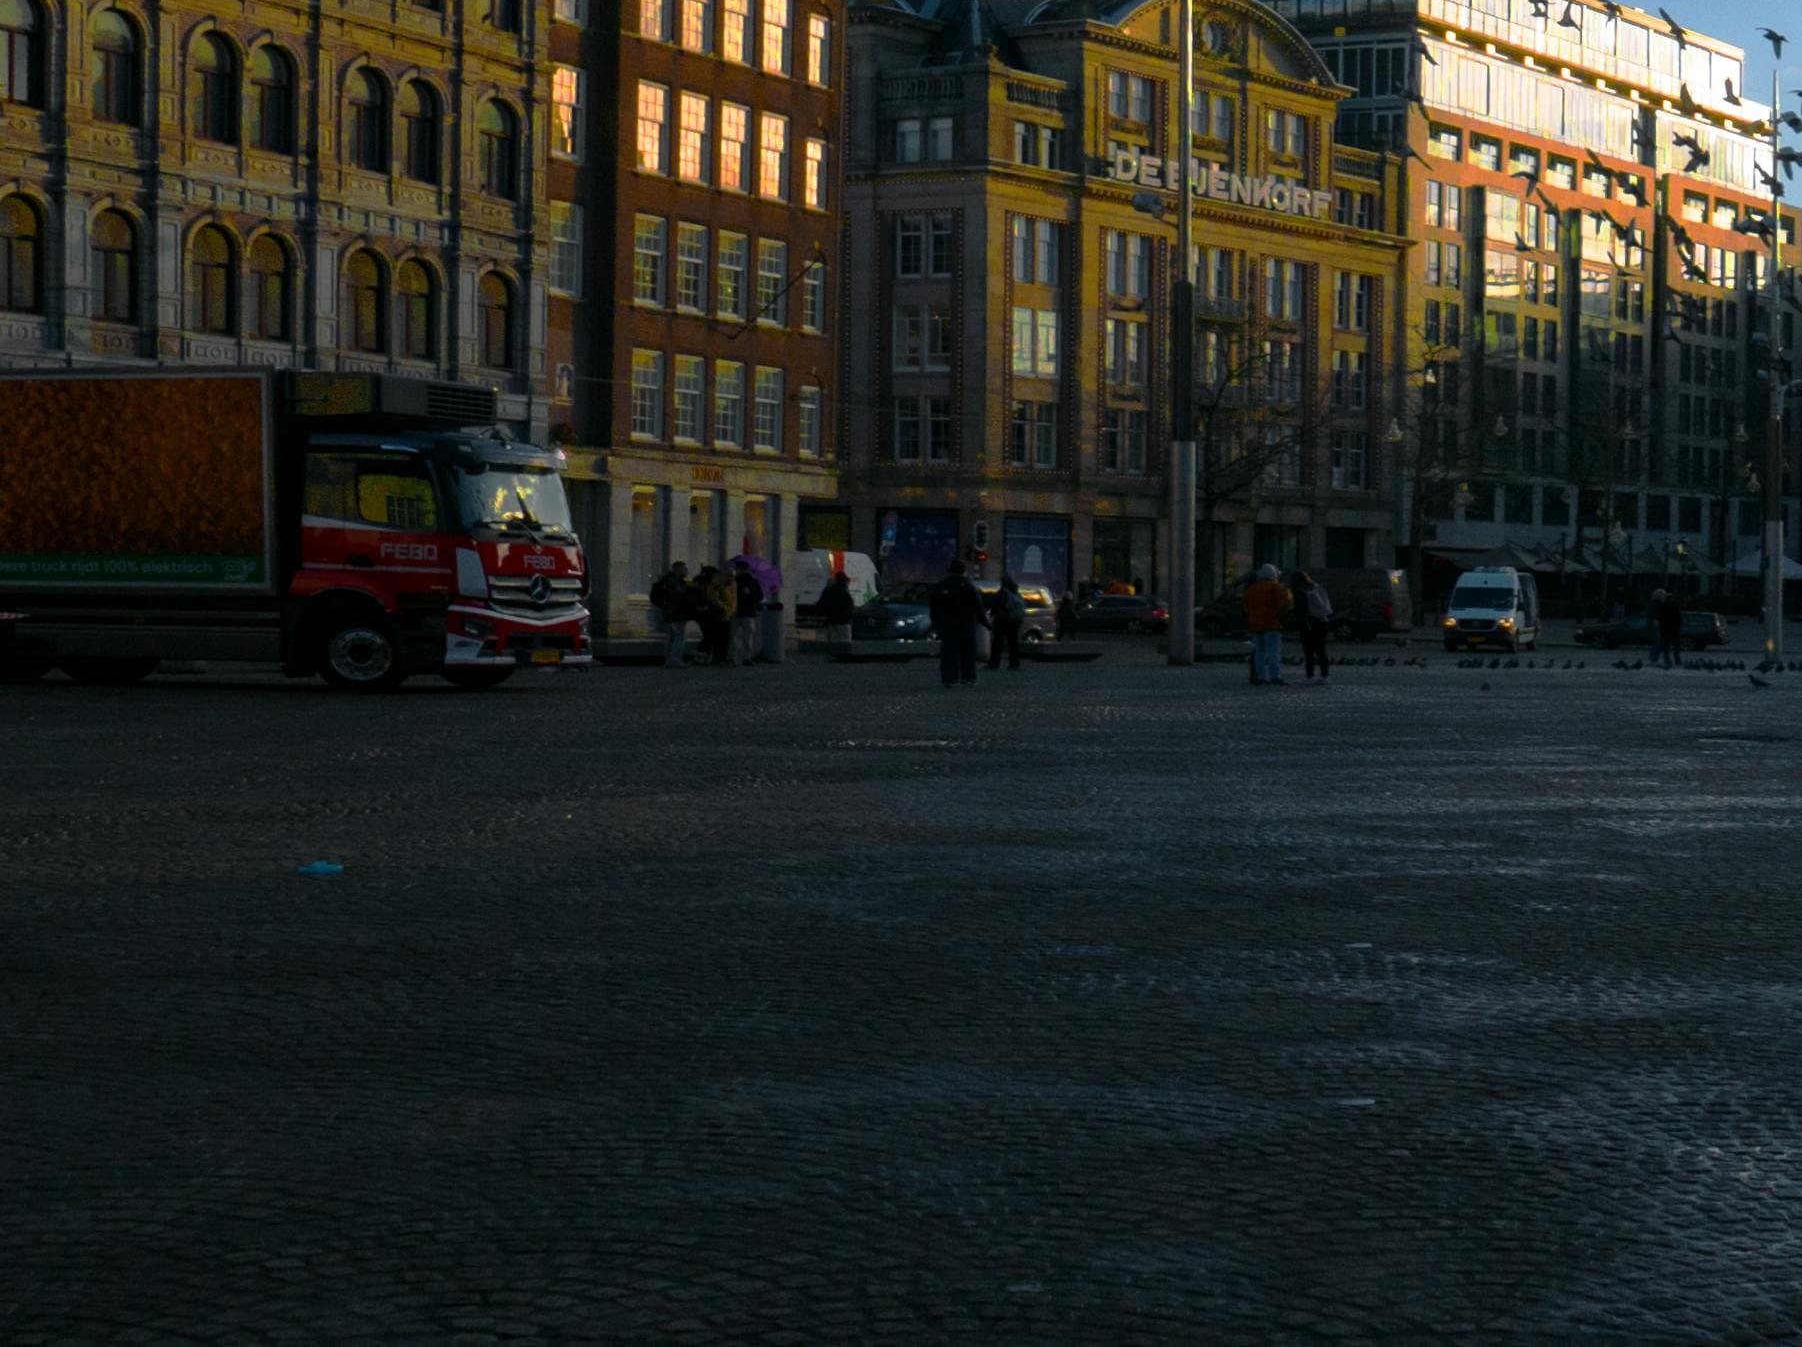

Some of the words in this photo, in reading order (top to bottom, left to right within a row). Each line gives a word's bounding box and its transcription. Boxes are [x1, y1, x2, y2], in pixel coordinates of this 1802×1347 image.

[1115, 150, 1161, 188] DE
[1167, 161, 1333, 217] BJENKORF
[380, 541, 439, 561] FEBO
[523, 554, 556, 570] FEBO
